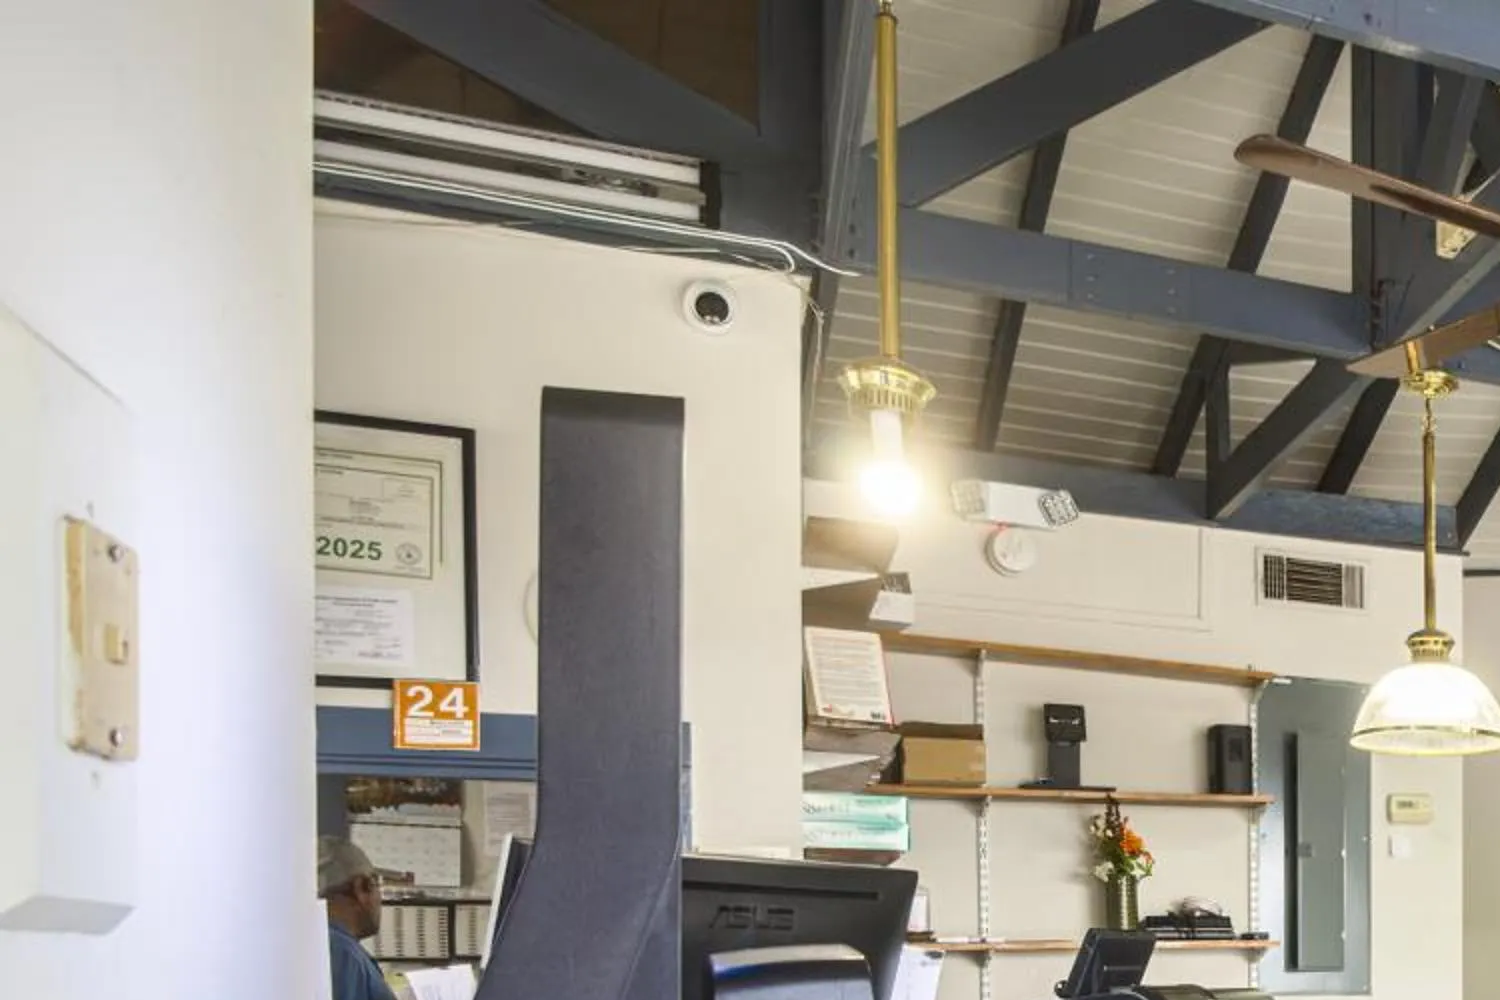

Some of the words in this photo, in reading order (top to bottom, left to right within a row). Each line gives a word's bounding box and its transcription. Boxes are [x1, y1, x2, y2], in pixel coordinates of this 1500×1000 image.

[316, 536, 383, 561] 2025
[406, 685, 469, 719] 24
[708, 905, 795, 930] ASUS
